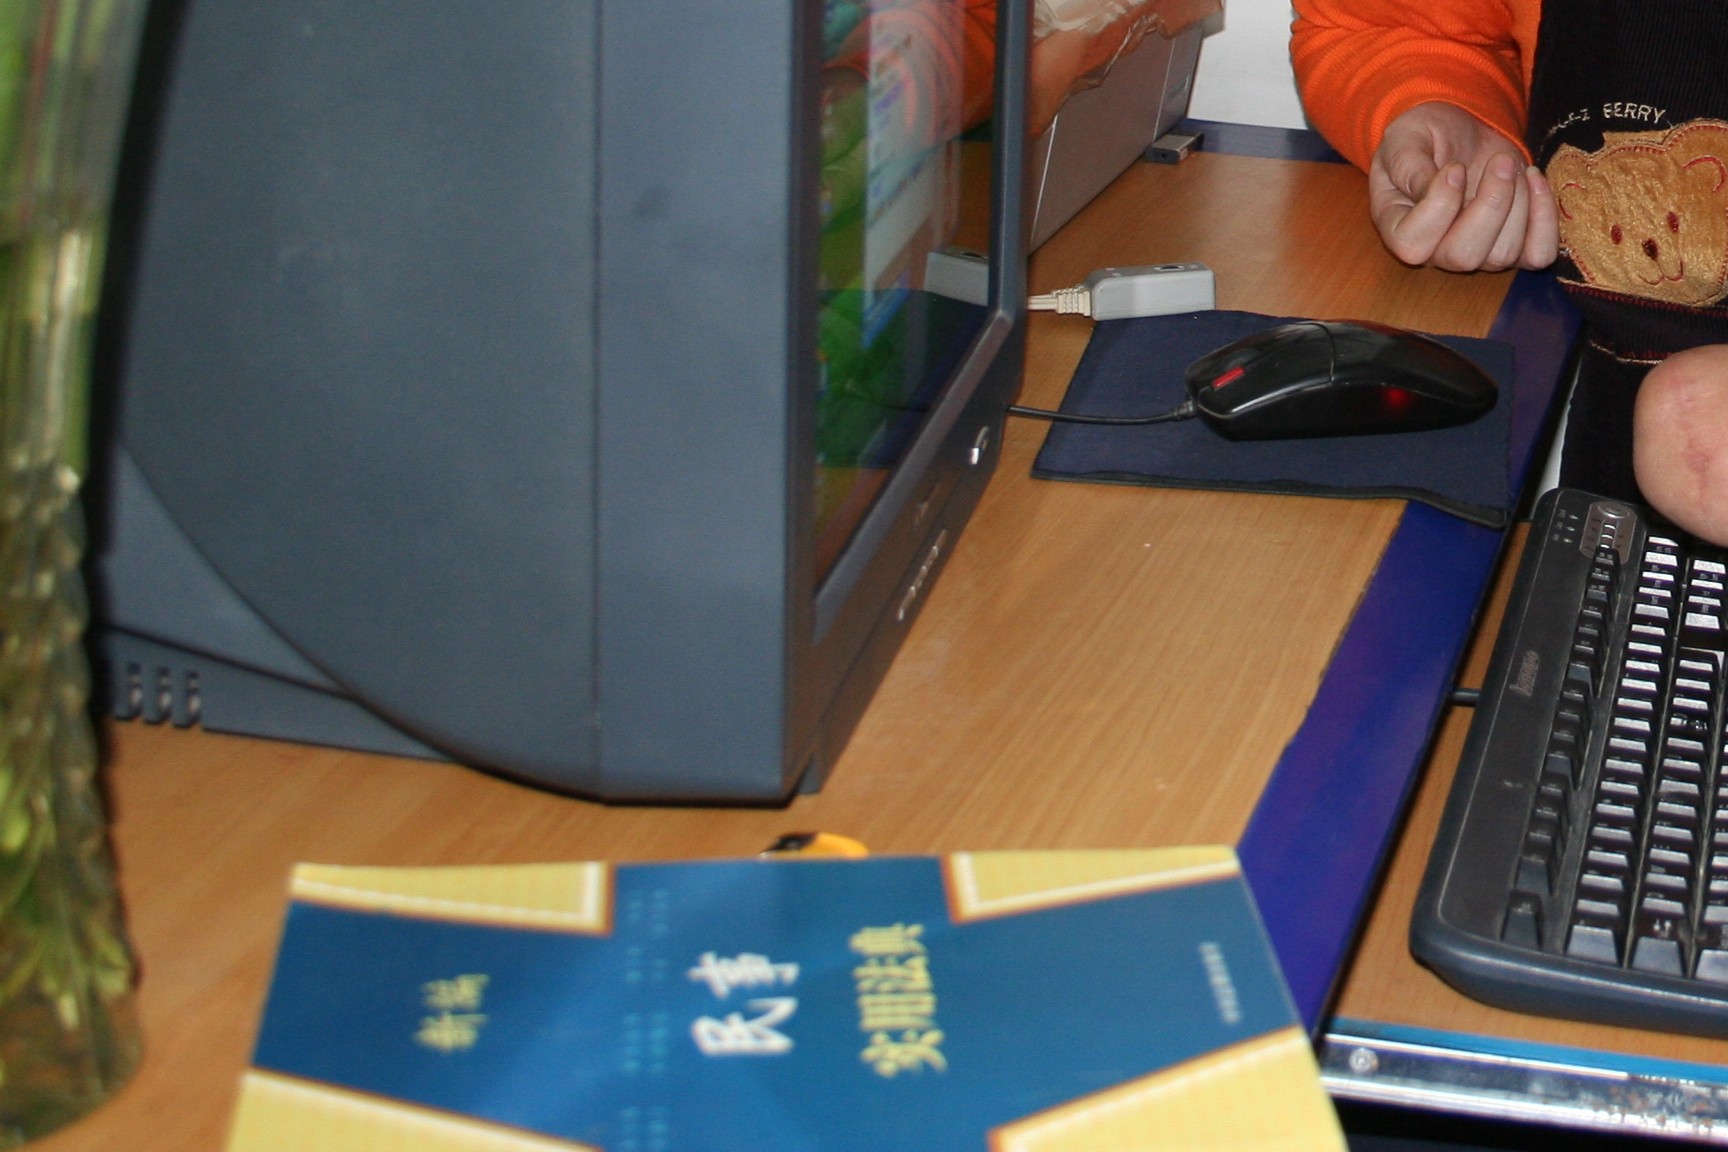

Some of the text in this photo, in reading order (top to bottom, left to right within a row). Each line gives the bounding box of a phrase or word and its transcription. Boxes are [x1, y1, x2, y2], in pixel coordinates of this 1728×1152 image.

[687, 951, 798, 1055] 民事
[849, 923, 947, 1077] 实用法典
